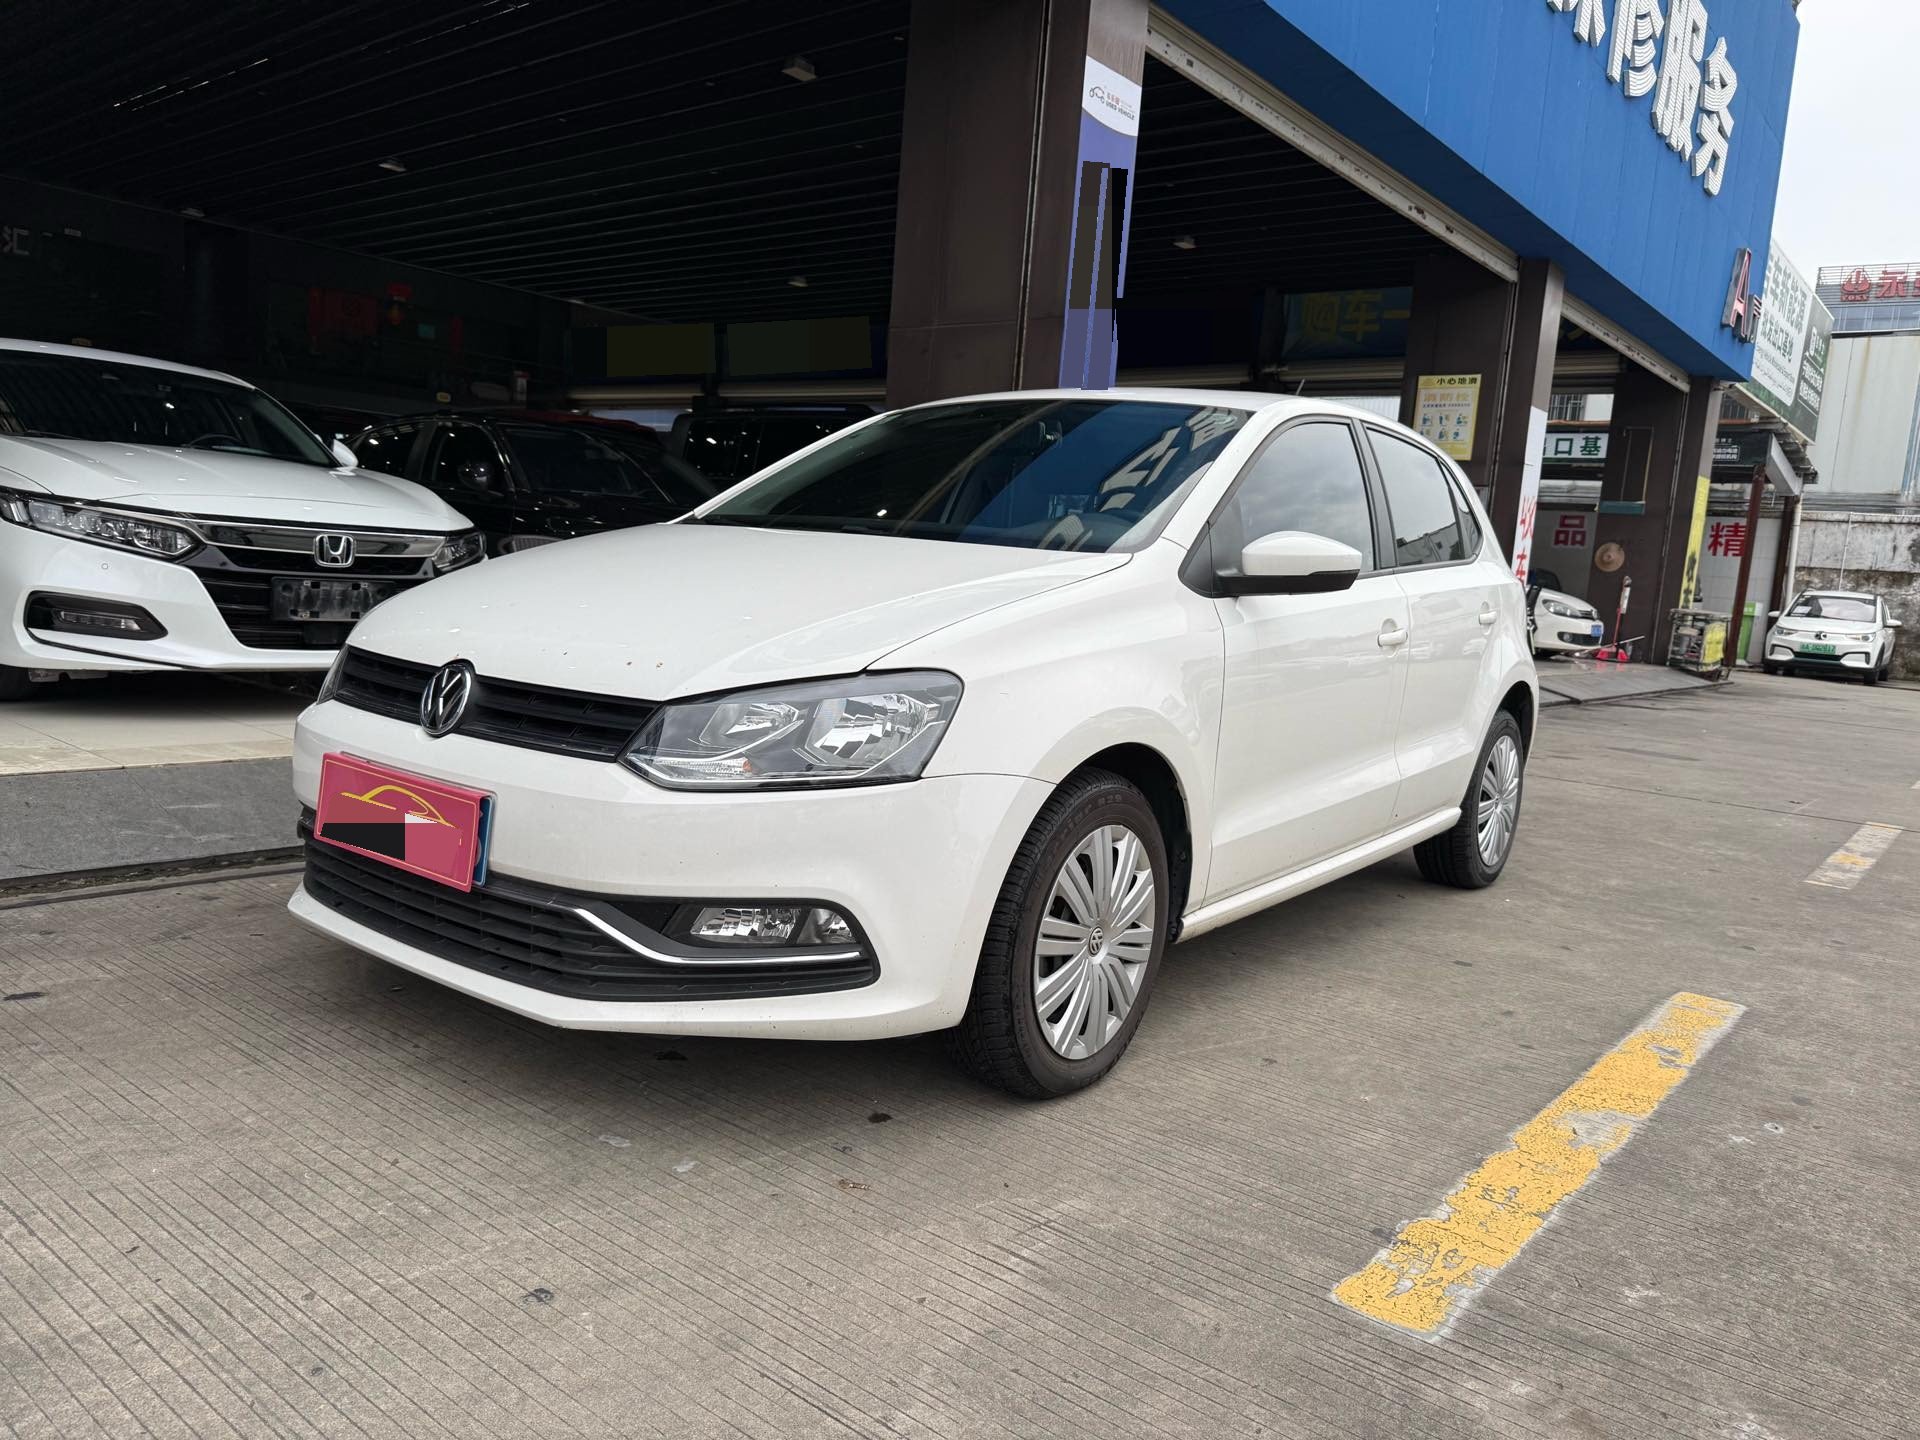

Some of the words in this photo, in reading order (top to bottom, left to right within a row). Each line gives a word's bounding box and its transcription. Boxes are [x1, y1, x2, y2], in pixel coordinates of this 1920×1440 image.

[1546, 0, 1738, 197] 修服务
[1875, 269, 1920, 298] 永
[1543, 435, 1602, 456] 口基
[1553, 514, 1586, 547] 品
[1707, 521, 1747, 557] 精
